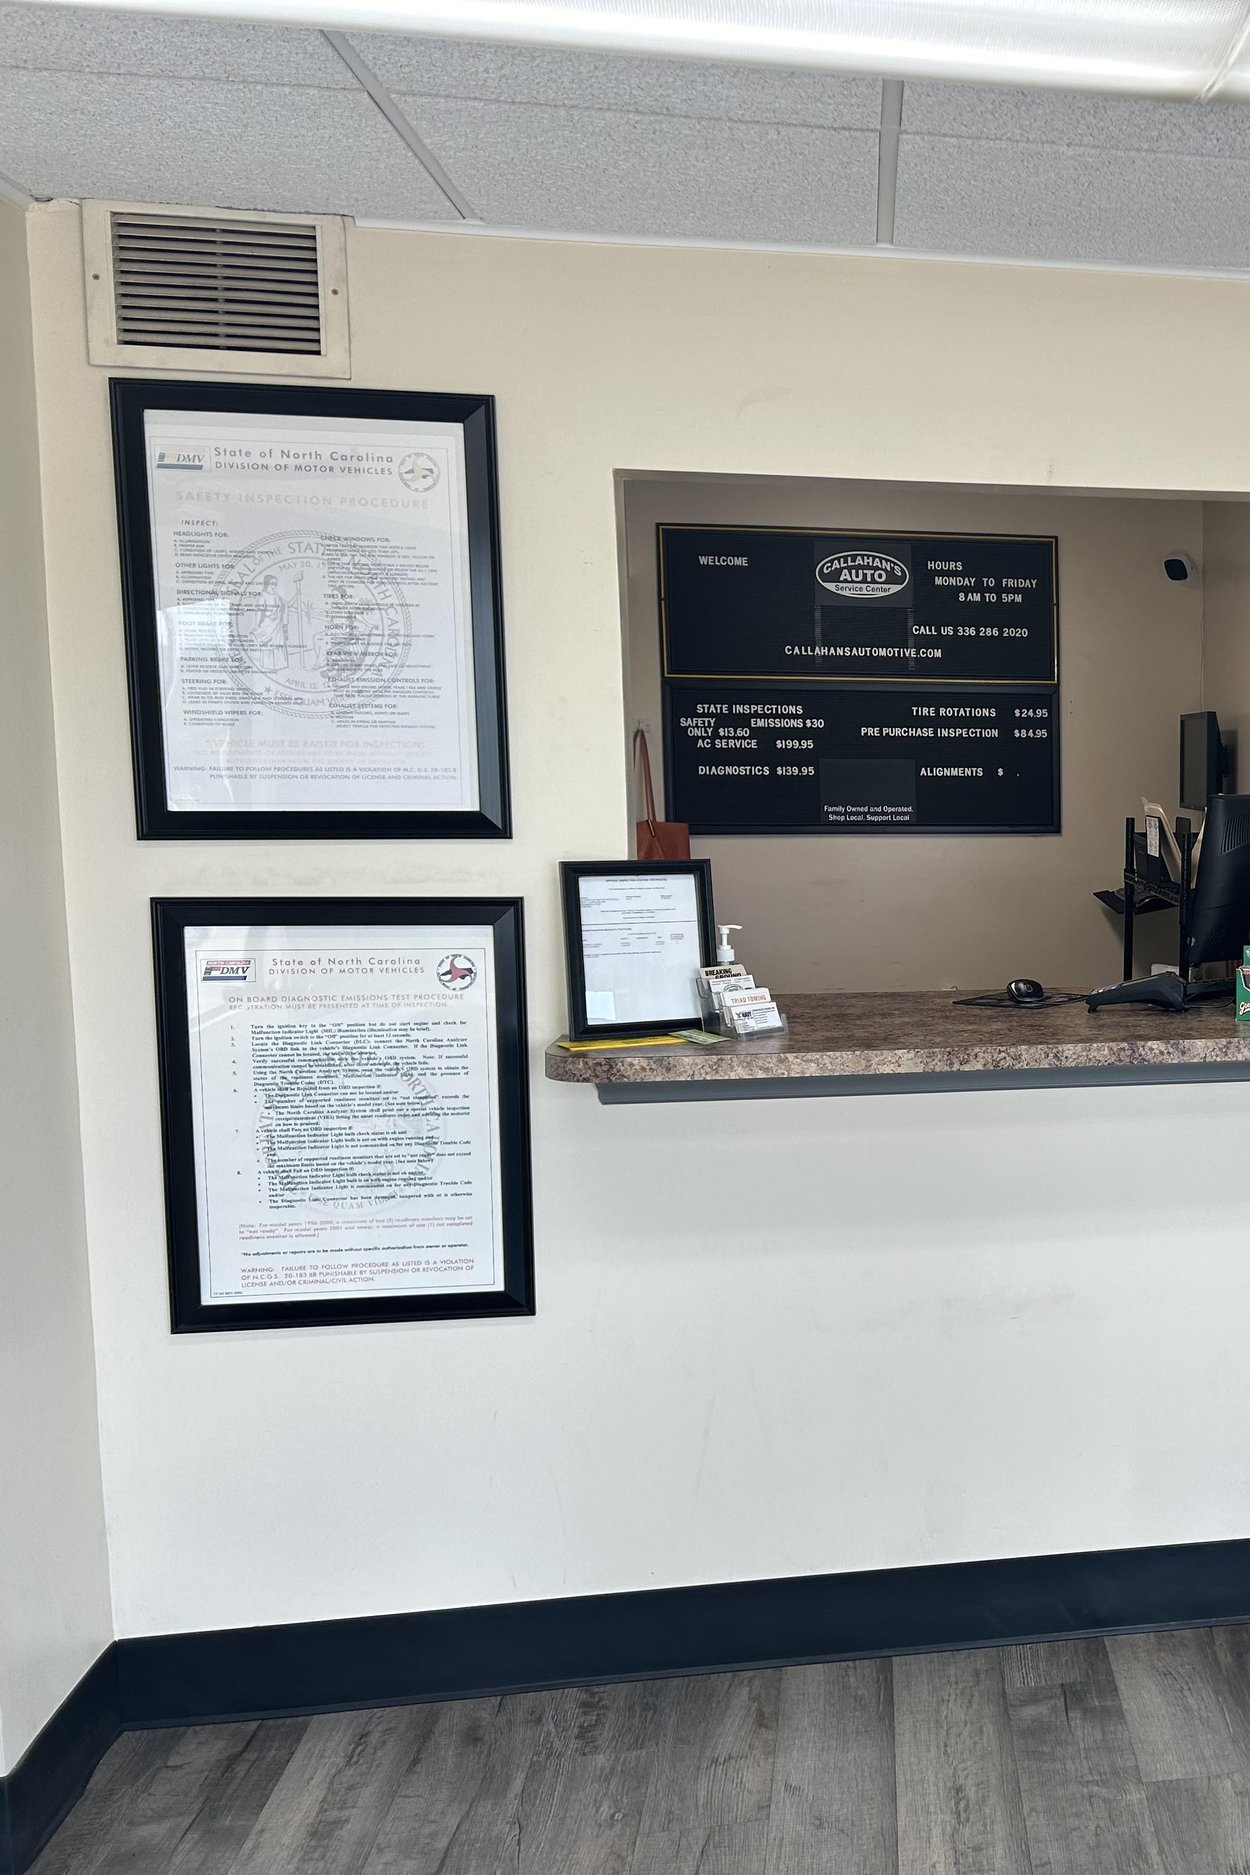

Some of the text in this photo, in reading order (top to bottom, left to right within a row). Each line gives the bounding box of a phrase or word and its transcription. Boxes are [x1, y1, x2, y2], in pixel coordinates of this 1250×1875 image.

[176, 454, 205, 463] DMV
[214, 448, 393, 463] State of North Carolina
[215, 462, 392, 475] DIVISION OF MOTOR VEHICLES
[176, 491, 428, 509] SAFETY INSPECTION PROCEDURE
[699, 556, 748, 566] WELCOME
[822, 556, 902, 577] CALLAHAN'S
[928, 562, 962, 570] HOURS
[840, 570, 888, 582] AUTO
[935, 577, 1037, 588] MONDAY TO FRIDAY
[834, 583, 891, 594] Service Center
[985, 594, 997, 602] TO
[1002, 594, 1022, 602] 5PM
[912, 626, 1028, 637] CALL US 336 286 2020
[785, 646, 942, 657] CALLAHANSAUTOMOTIVE.COM
[697, 704, 803, 714] STATE INSPECTIONS
[912, 707, 996, 717] TIRE ROTATIONS
[1014, 709, 1048, 718] $24.95
[680, 718, 715, 727] SAFETY
[751, 719, 824, 728] EMISSIONS $30
[688, 726, 750, 736] ONLY $13.60
[861, 728, 998, 737] PRE PURCHASE INSPECTION
[1014, 730, 1048, 738] $84.95
[697, 739, 814, 748] AC SERVICE $199.95
[698, 766, 814, 775] DIAGNOSTICS $139.95
[920, 768, 983, 776] ALIGNMENTS
[328, 958, 362, 966] North
[220, 967, 248, 976] DMV
[705, 968, 732, 976] BREAKING
[247, 994, 278, 1003] BOARD
